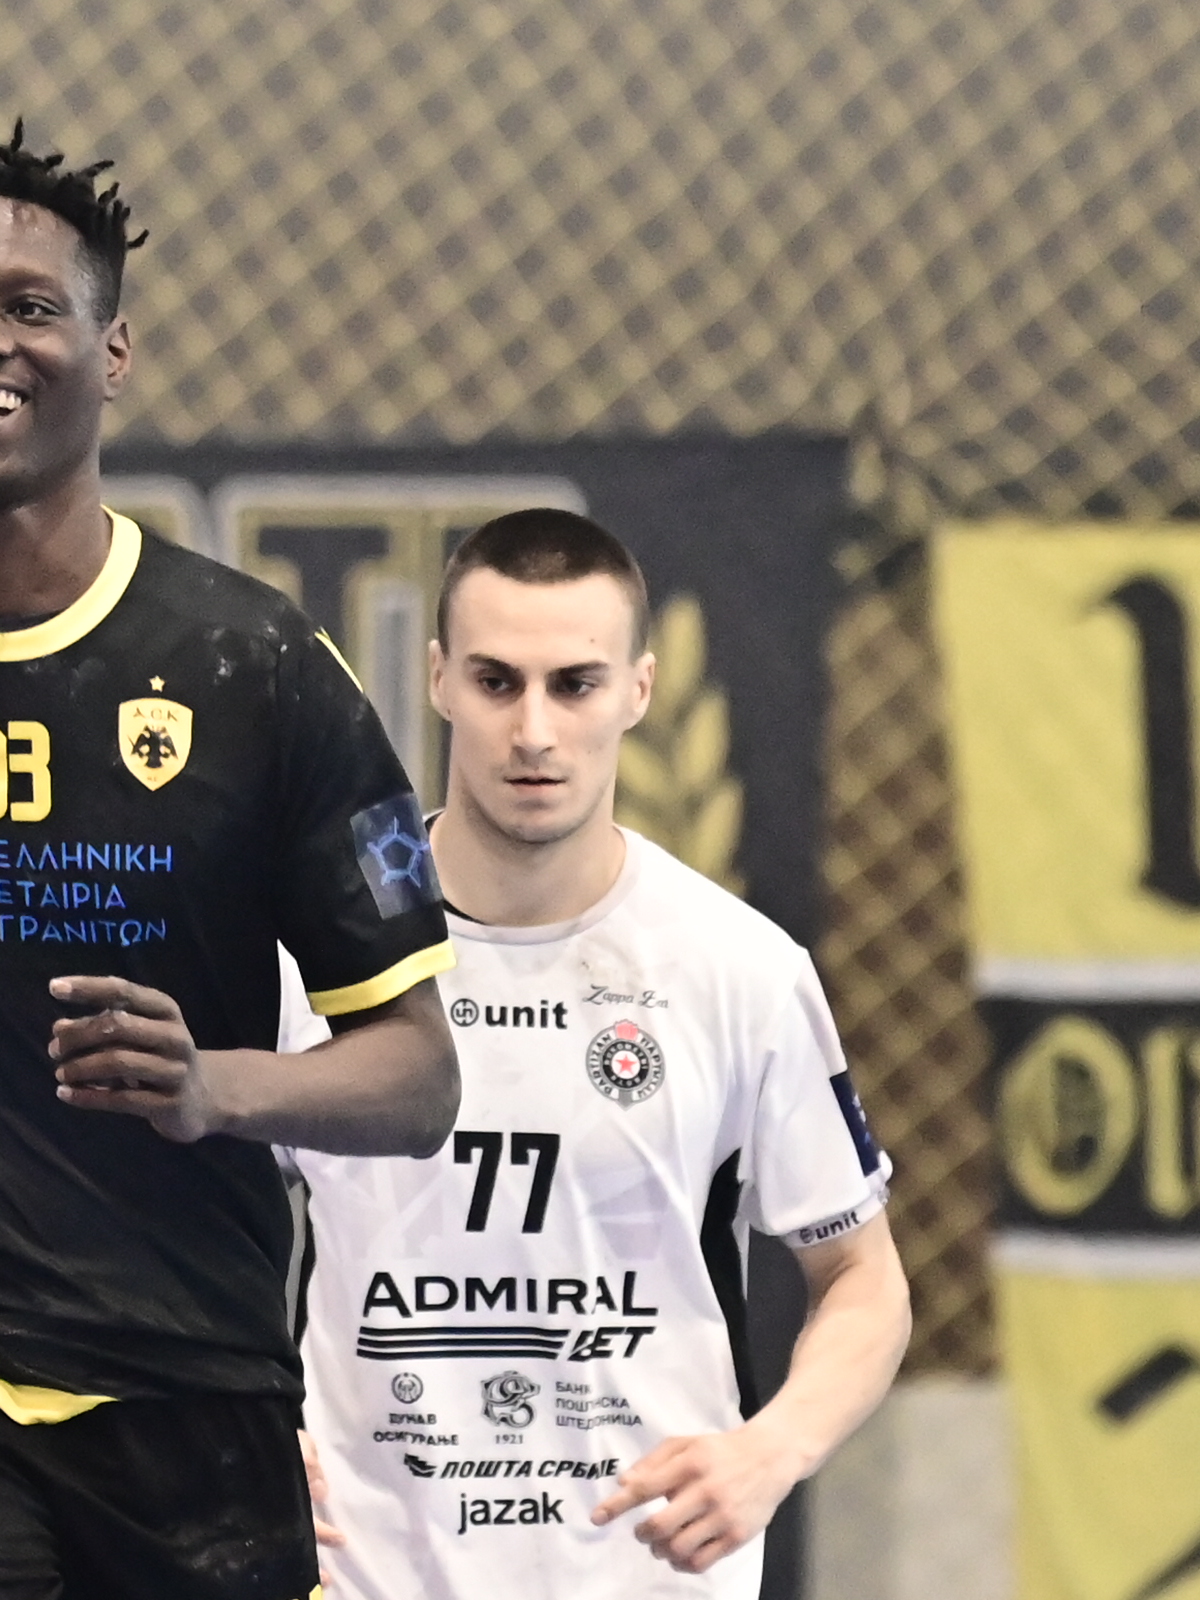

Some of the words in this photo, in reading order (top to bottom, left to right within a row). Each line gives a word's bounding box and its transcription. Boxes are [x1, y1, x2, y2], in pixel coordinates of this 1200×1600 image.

[0, 914, 167, 948] ΓΡΑΝΙΤΩΝ
[485, 1000, 568, 1029] unit
[453, 1130, 561, 1234] 77
[815, 1211, 860, 1239] unit
[362, 1270, 658, 1318] ADMIRAL
[567, 1326, 657, 1362] BET
[495, 1434, 524, 1445] 1921
[439, 1460, 532, 1479] ПОШТА
[457, 1491, 564, 1535] jazak
